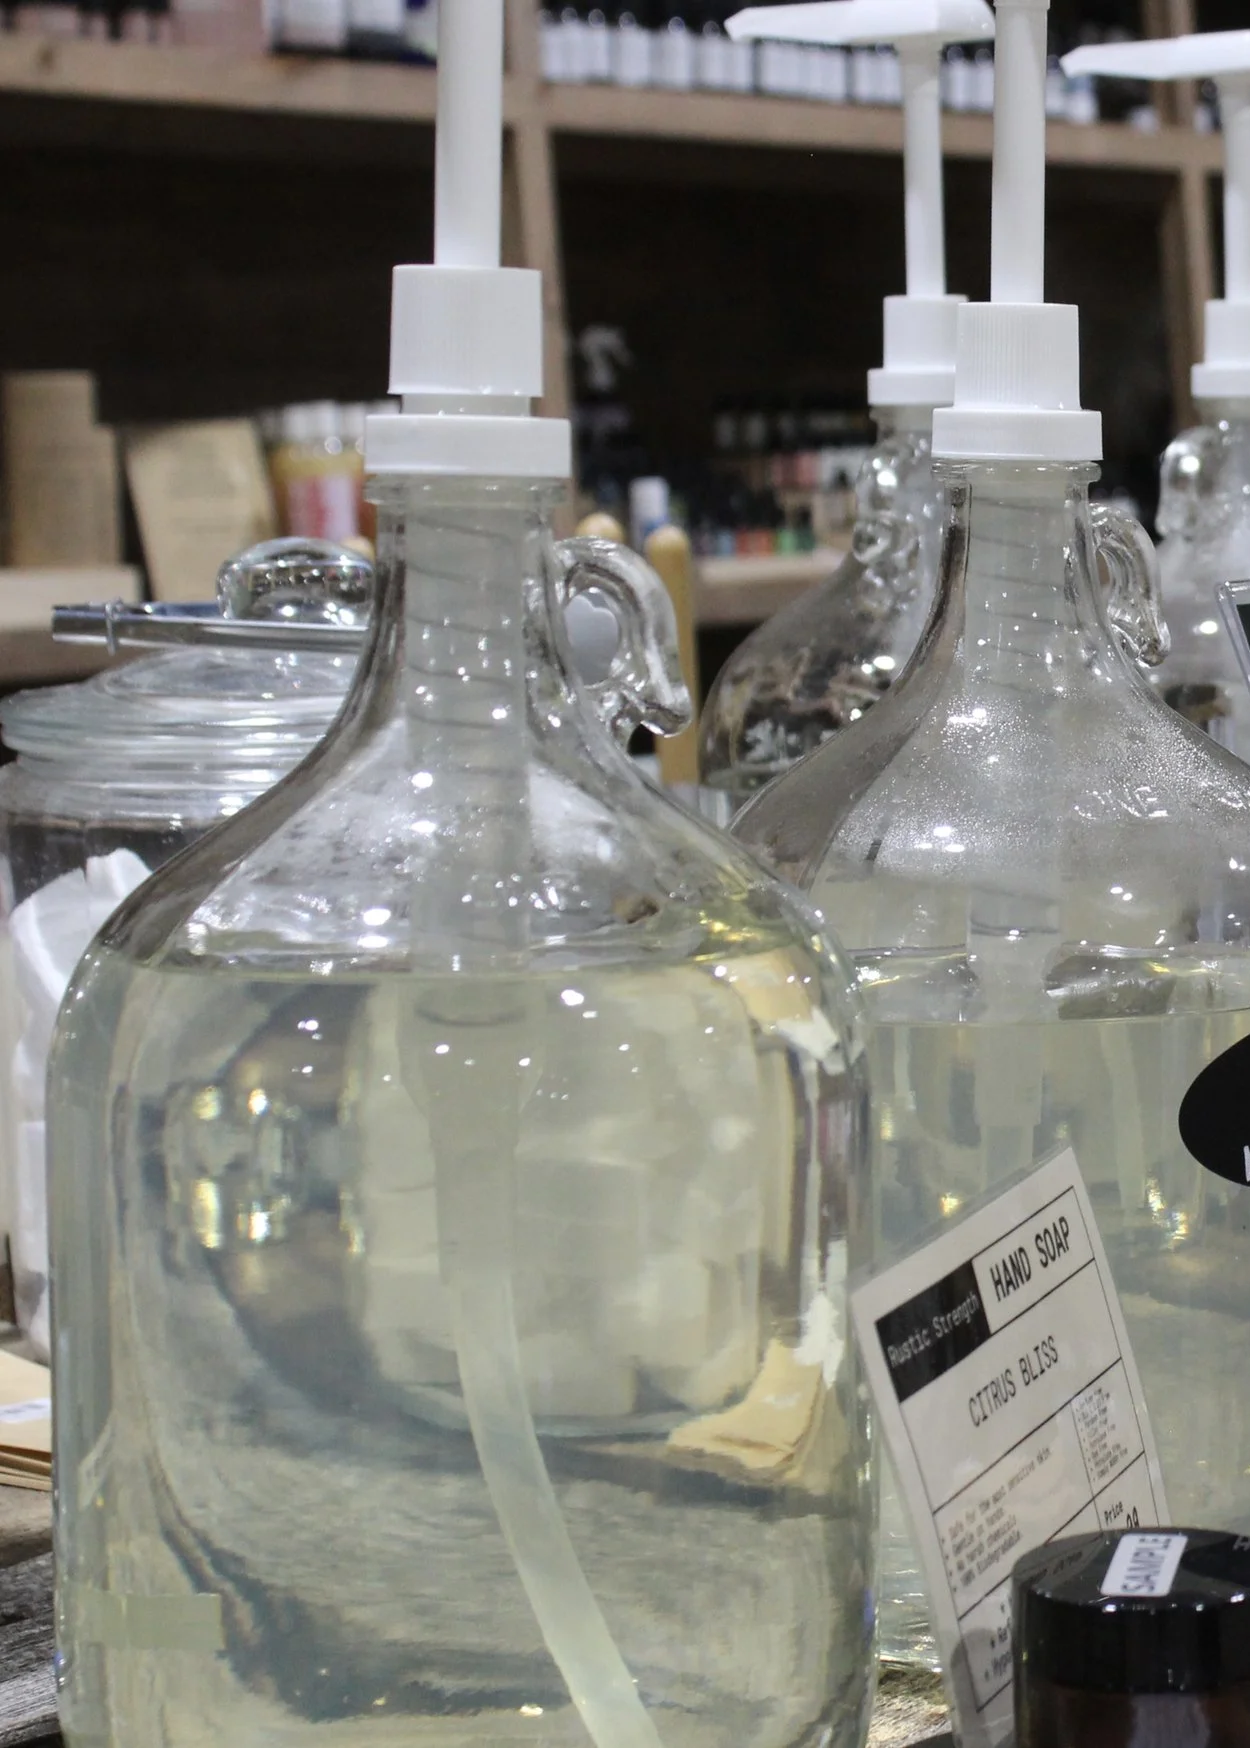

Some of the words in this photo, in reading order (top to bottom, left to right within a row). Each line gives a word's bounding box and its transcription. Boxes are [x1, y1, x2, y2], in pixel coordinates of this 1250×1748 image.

[990, 1247, 1033, 1301] HAND
[1034, 1215, 1070, 1269] SOAP
[887, 1327, 931, 1368] Rustic
[932, 1290, 981, 1339] Strength
[968, 1367, 1017, 1428] CITRUS
[1018, 1335, 1059, 1387] BLISS
[1103, 1501, 1124, 1527] Price
[1121, 1536, 1173, 1594] SAMPLE
